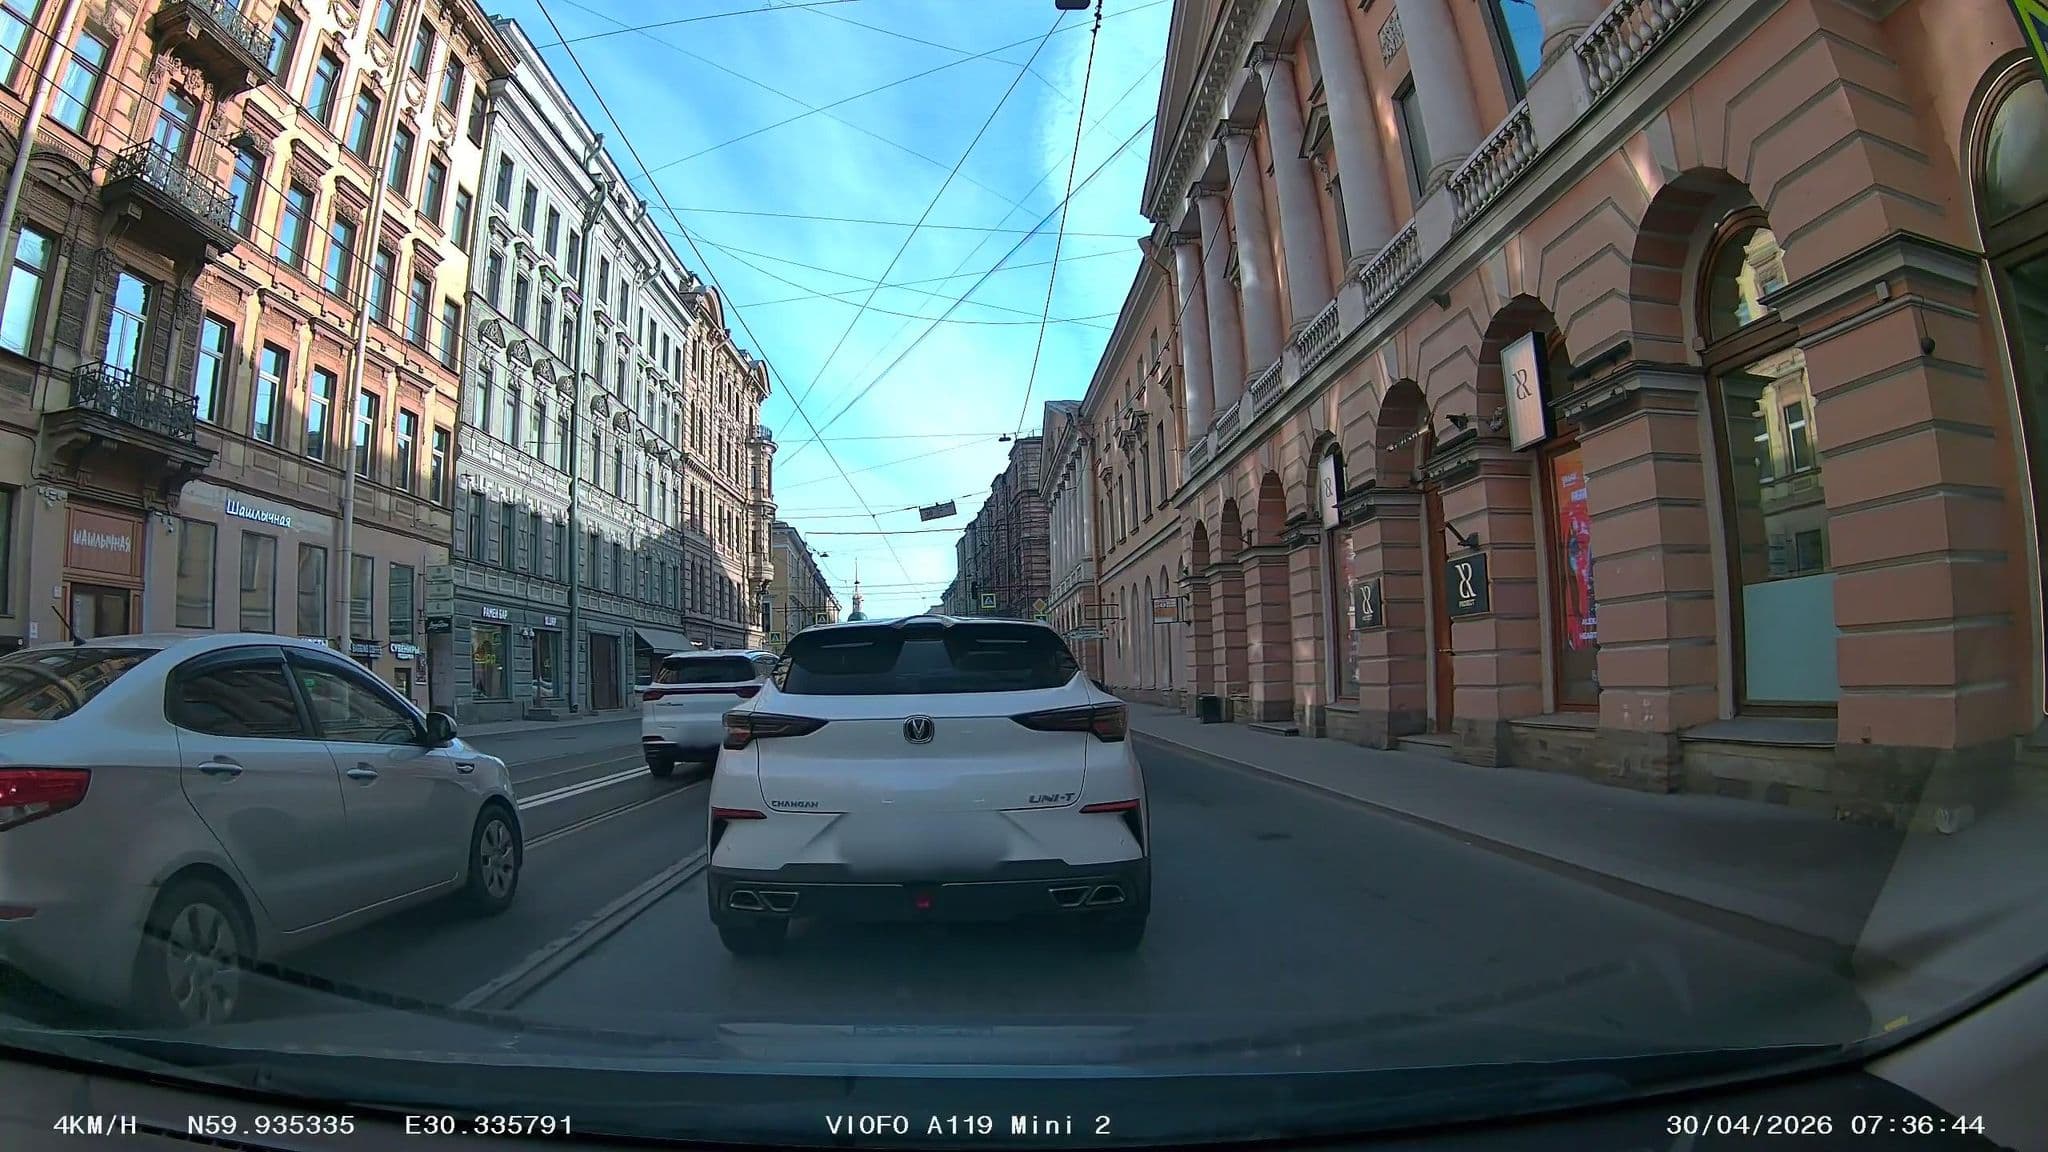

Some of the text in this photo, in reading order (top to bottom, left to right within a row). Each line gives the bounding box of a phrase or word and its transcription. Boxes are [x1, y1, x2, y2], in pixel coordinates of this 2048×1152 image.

[226, 499, 292, 528] Шашлычная
[73, 529, 131, 553] ШАШЛЫЧНАЯ
[771, 800, 819, 808] CHANGAN
[1029, 792, 1076, 804] UNI-T
